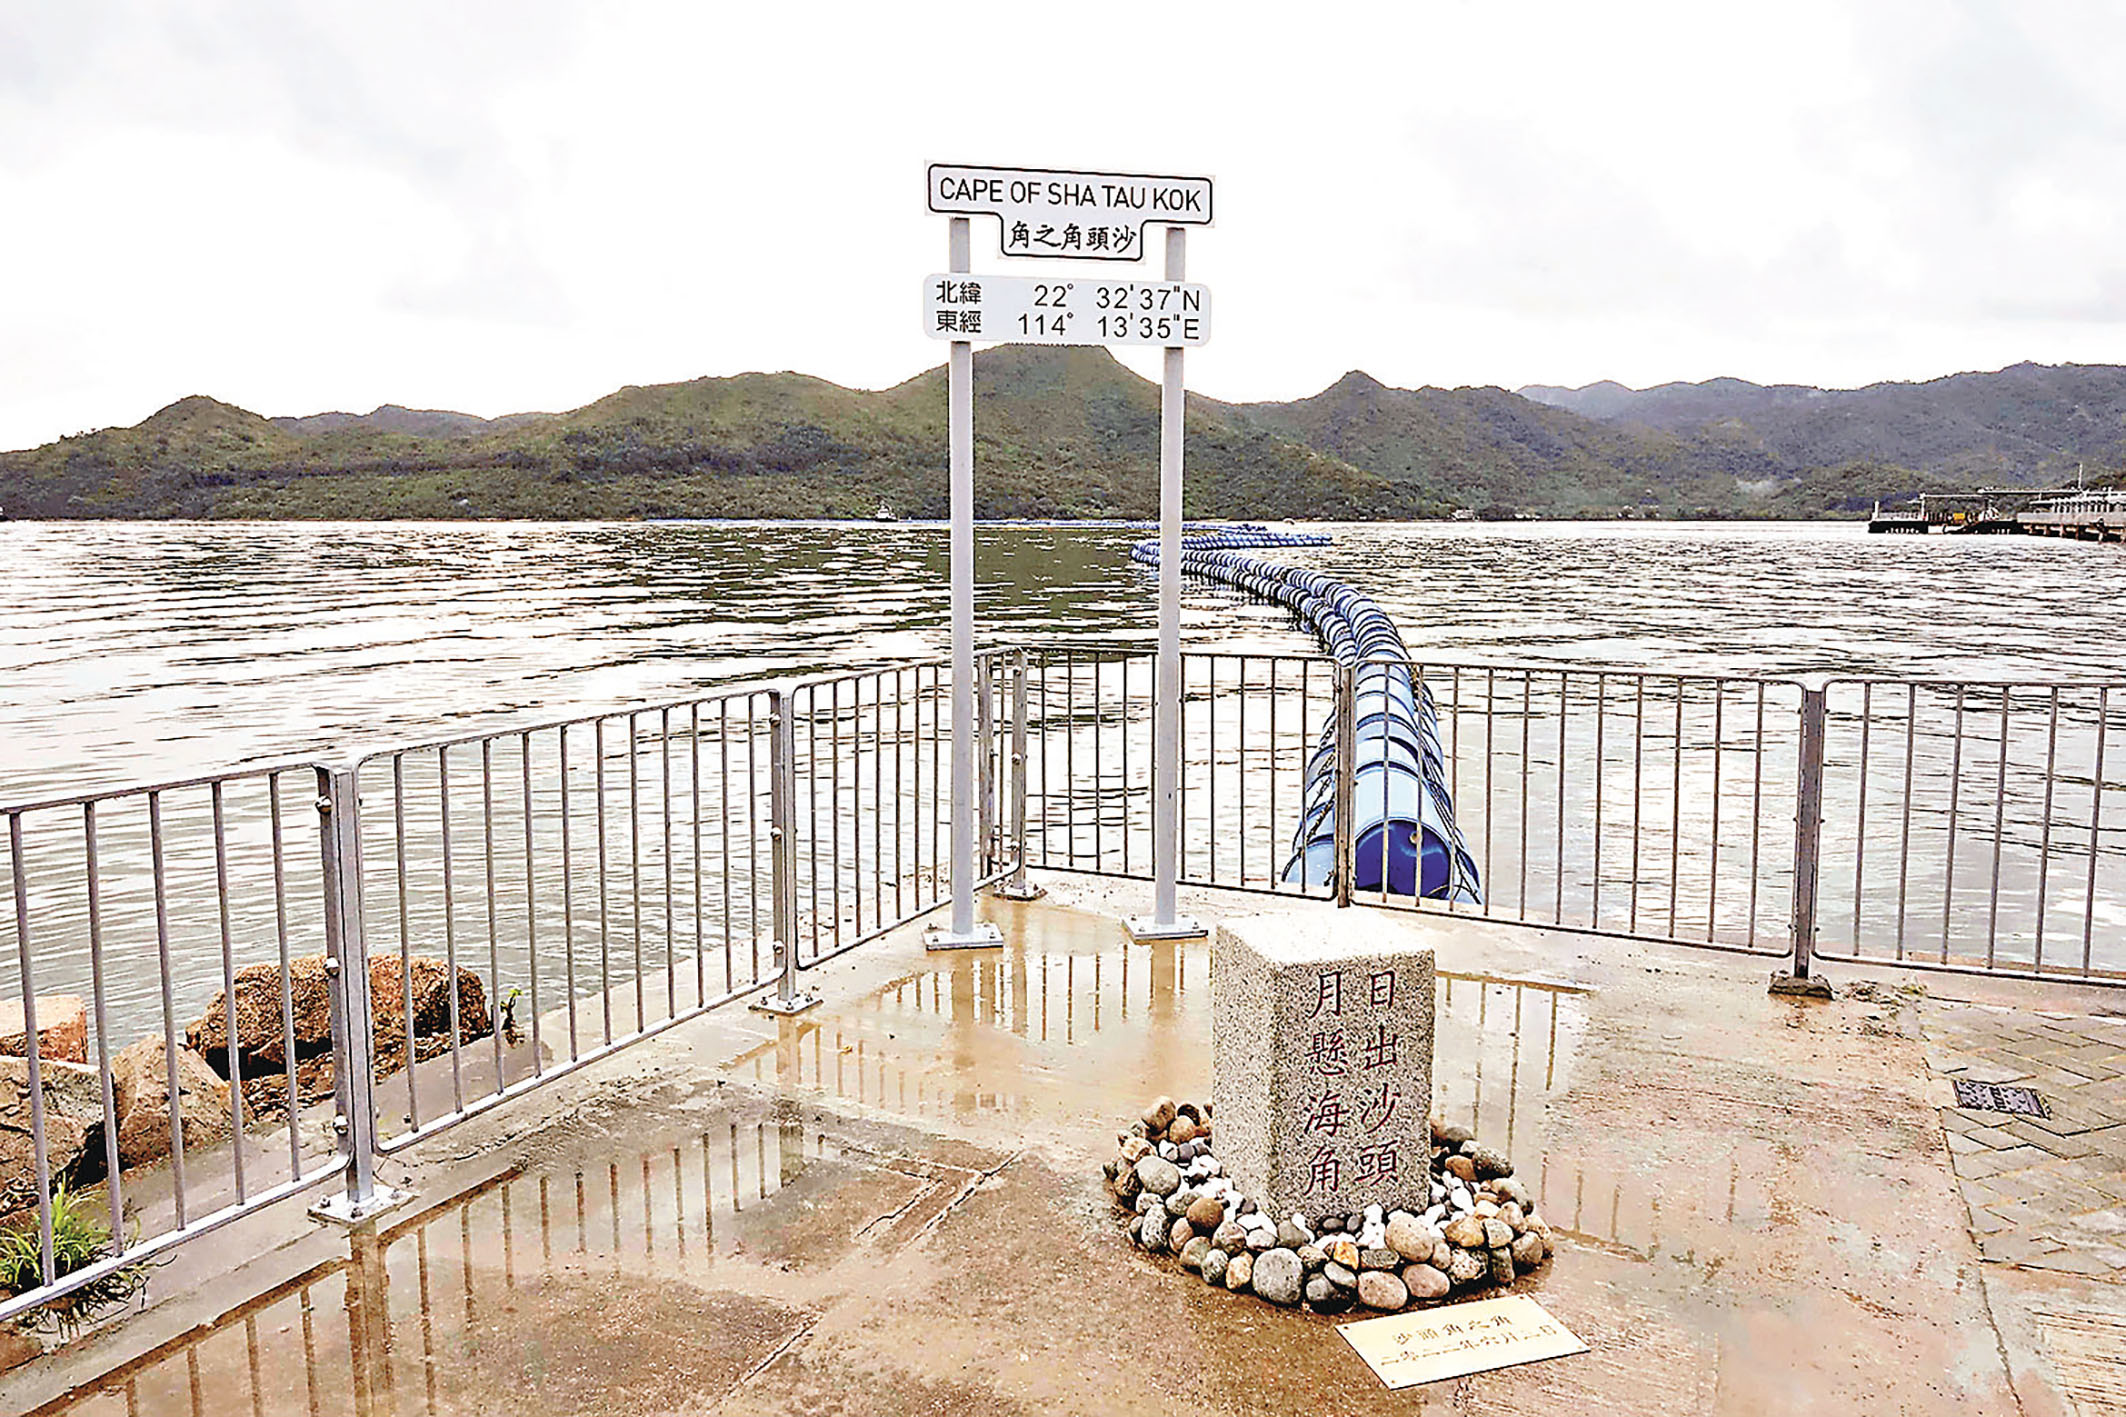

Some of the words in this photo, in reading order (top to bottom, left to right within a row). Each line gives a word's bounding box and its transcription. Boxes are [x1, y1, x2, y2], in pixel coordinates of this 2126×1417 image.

[940, 177, 1003, 202] CAPE
[1010, 181, 1041, 203] OF
[1048, 182, 1096, 206] SHA
[1102, 185, 1145, 209] TAU
[1153, 187, 1201, 212] KOK
[936, 280, 982, 305] 北緯
[936, 310, 982, 333] 東經
[1303, 970, 1350, 1197] 月懸海角
[1354, 969, 1401, 1187] 日出沙頭
